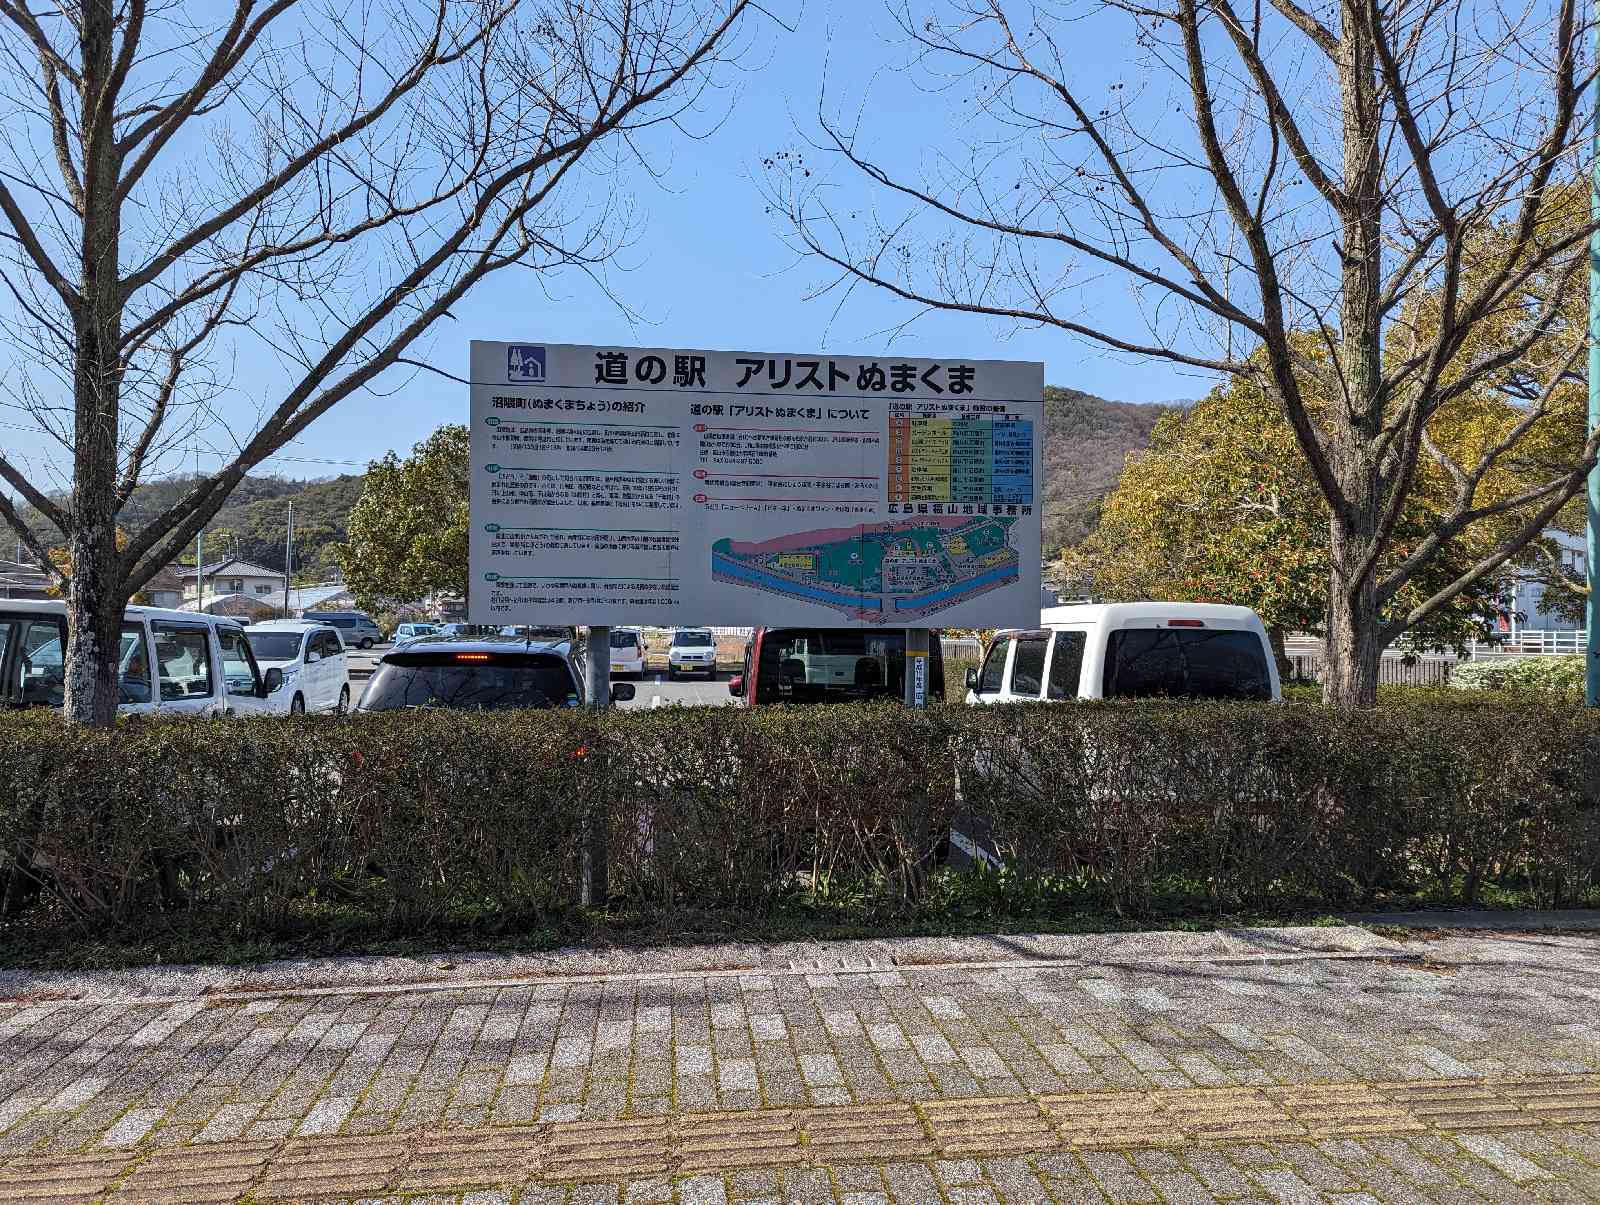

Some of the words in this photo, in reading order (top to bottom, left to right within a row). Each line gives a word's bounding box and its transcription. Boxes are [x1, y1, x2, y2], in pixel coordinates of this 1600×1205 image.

[594, 351, 706, 388] 道の駅
[735, 358, 975, 394] アリストぬまくま
